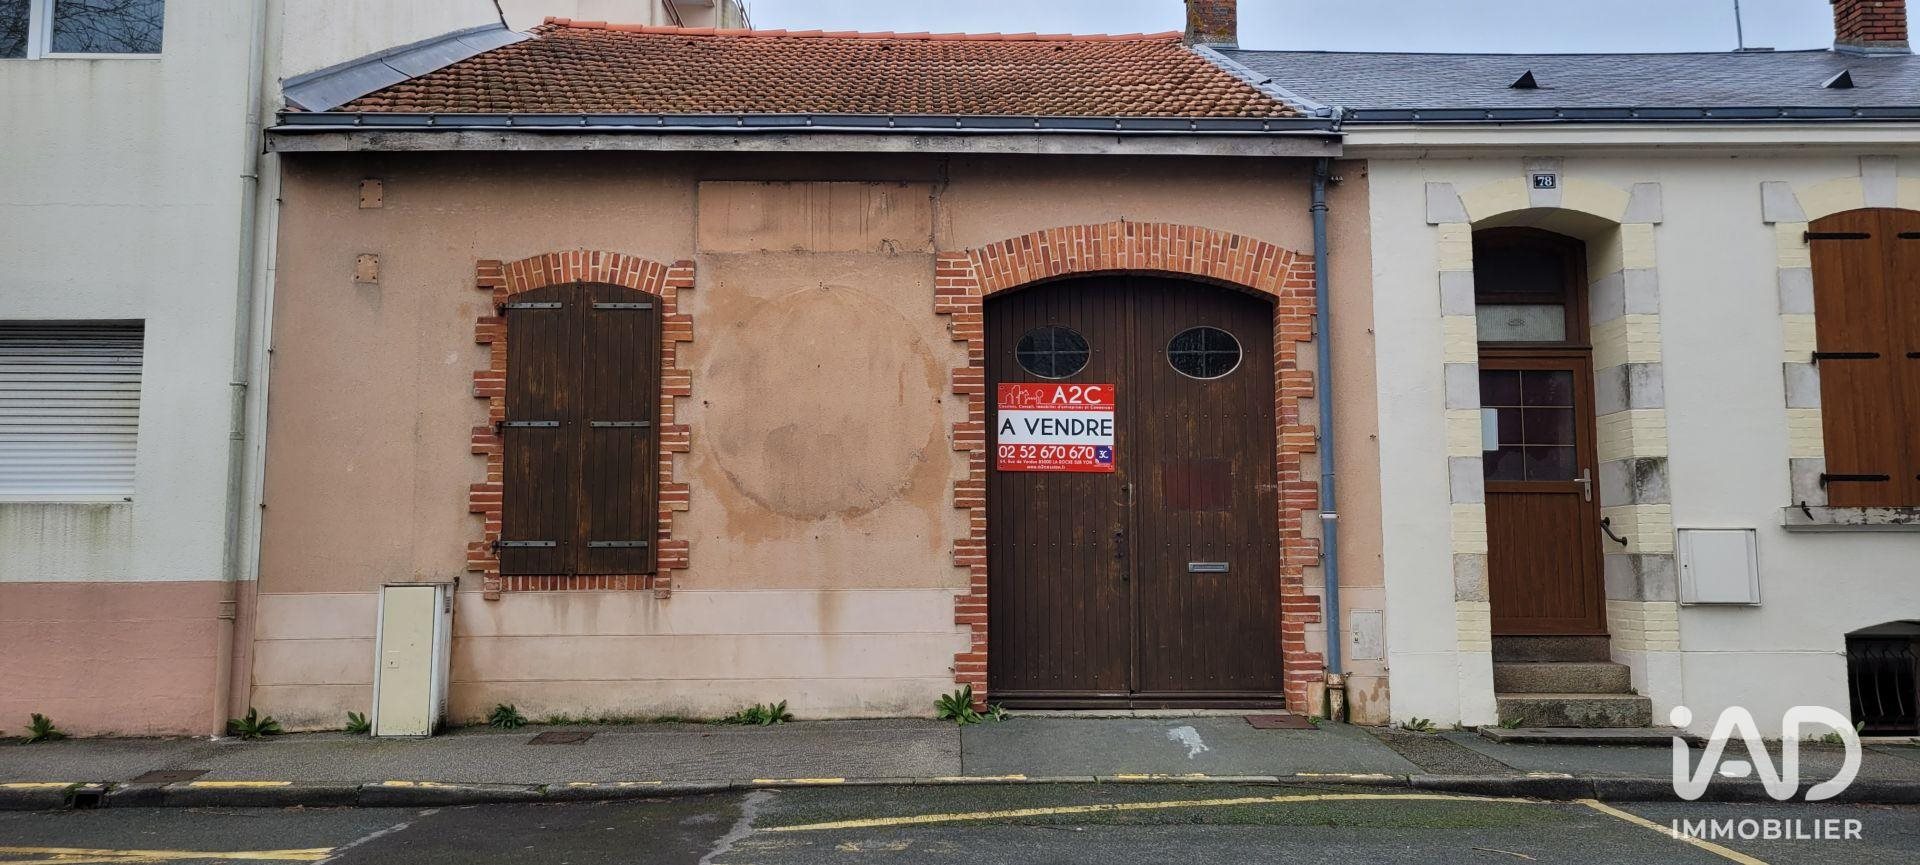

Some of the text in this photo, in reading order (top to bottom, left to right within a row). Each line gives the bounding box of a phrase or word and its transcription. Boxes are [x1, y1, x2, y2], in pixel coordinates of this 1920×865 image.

[1537, 176, 1552, 186] 78
[1052, 385, 1101, 404] A2C
[1000, 418, 1112, 436] A VENDRE
[998, 445, 1095, 459] 02 52 670 670
